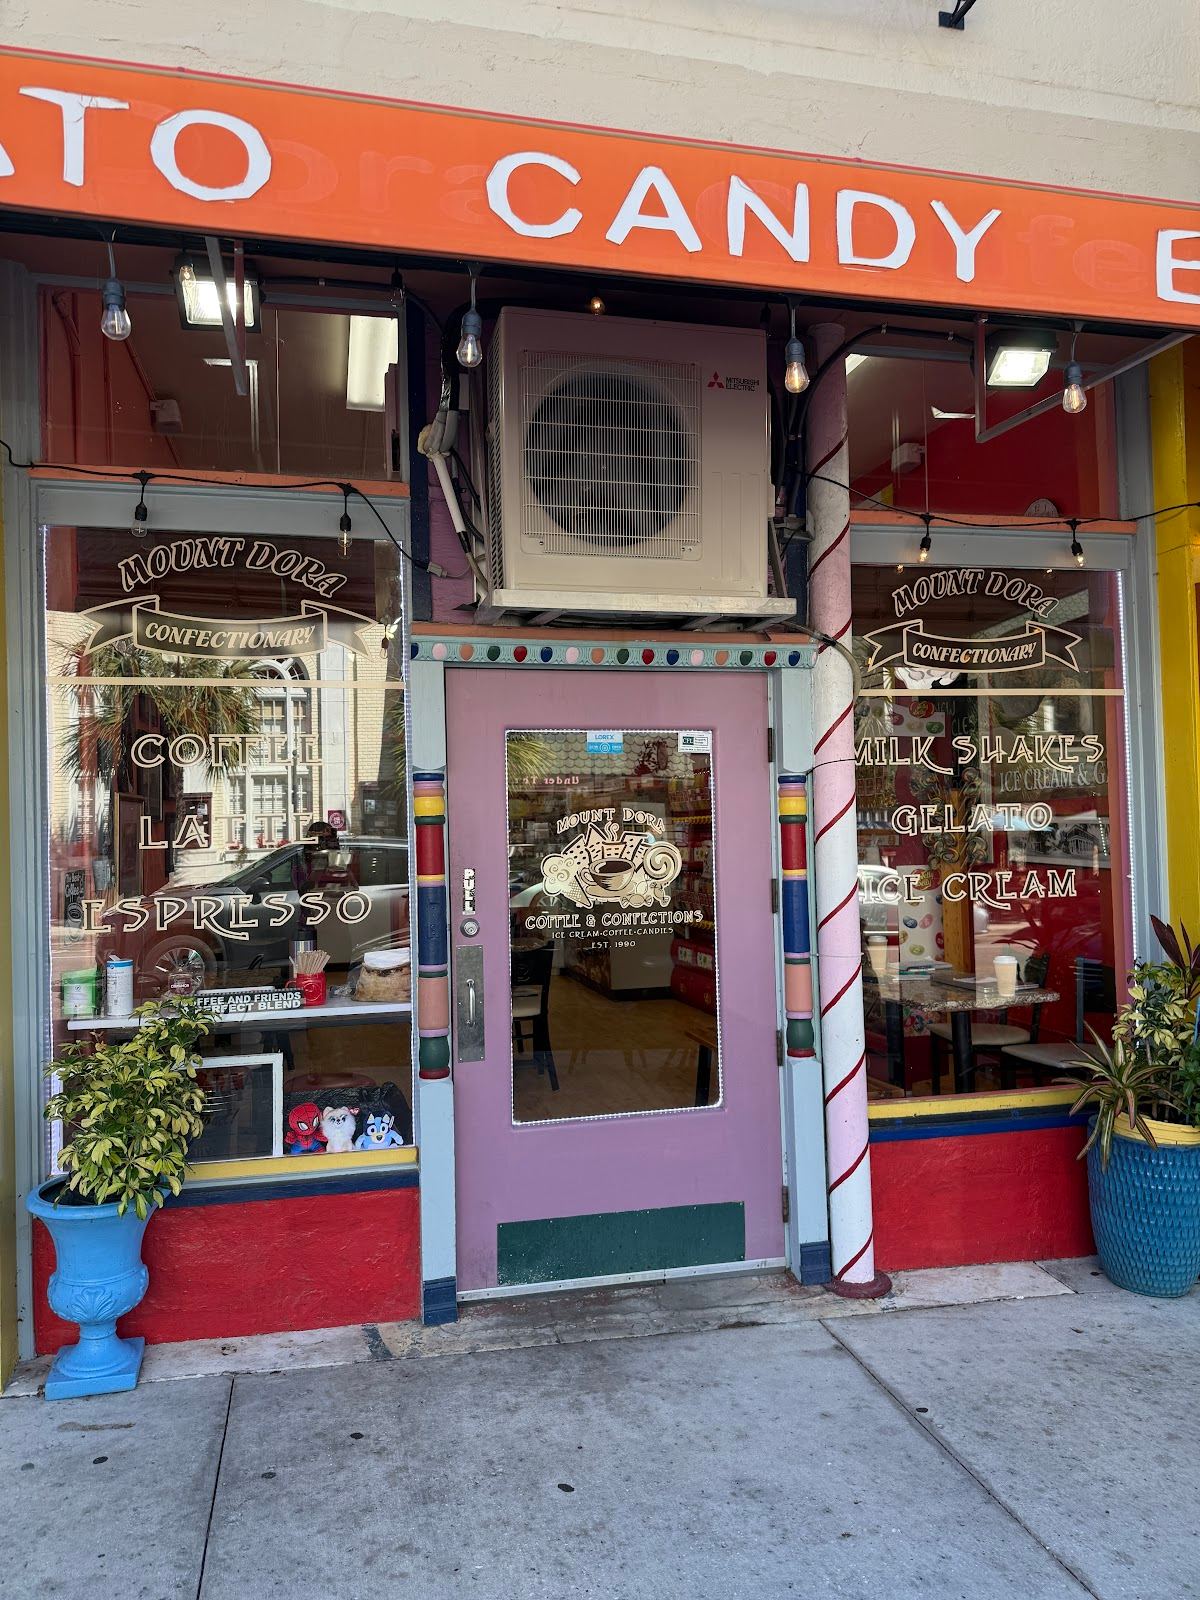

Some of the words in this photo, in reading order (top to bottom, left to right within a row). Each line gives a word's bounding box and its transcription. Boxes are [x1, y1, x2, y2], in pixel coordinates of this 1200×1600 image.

[0, 86, 272, 203] TO
[486, 151, 1002, 284] CANDY
[1156, 229, 1200, 305] E
[725, 376, 760, 386] MITSUBISHI
[725, 383, 756, 391] ELECTRIC
[117, 537, 245, 592] MOUNT
[246, 541, 347, 598] DORA
[892, 568, 984, 617] MOUNT
[985, 571, 1059, 618] DORA
[145, 622, 316, 650] CONFECTIONARY
[912, 642, 1037, 664] CONFECTIONARY
[130, 733, 323, 768] COFFEE
[854, 736, 953, 775] MILK
[952, 734, 1104, 773] SHAKES
[1000, 770, 1022, 792] ICE
[1024, 767, 1074, 790] CREAM
[1077, 762, 1091, 786] &
[1094, 760, 1108, 785] G
[138, 813, 319, 849] LATTE
[556, 807, 615, 834] MOUNT
[622, 807, 666, 834] DORA
[891, 802, 1053, 837] GELATO
[463, 868, 475, 912] PULL
[858, 873, 925, 904] ICE
[942, 869, 1076, 910] CREAM
[81, 890, 372, 941] ESPRESSO
[525, 914, 581, 930] COFFEE
[585, 914, 597, 928] &
[601, 909, 704, 926] CONFECTIONS
[552, 931, 566, 939] ICE
[591, 941, 612, 949] EST.
[615, 940, 636, 948] 1990
[193, 996, 225, 1006] FFEE
[227, 994, 251, 1004] AND
[254, 991, 301, 1002] FRIENDS
[257, 1000, 301, 1010] BLEND
